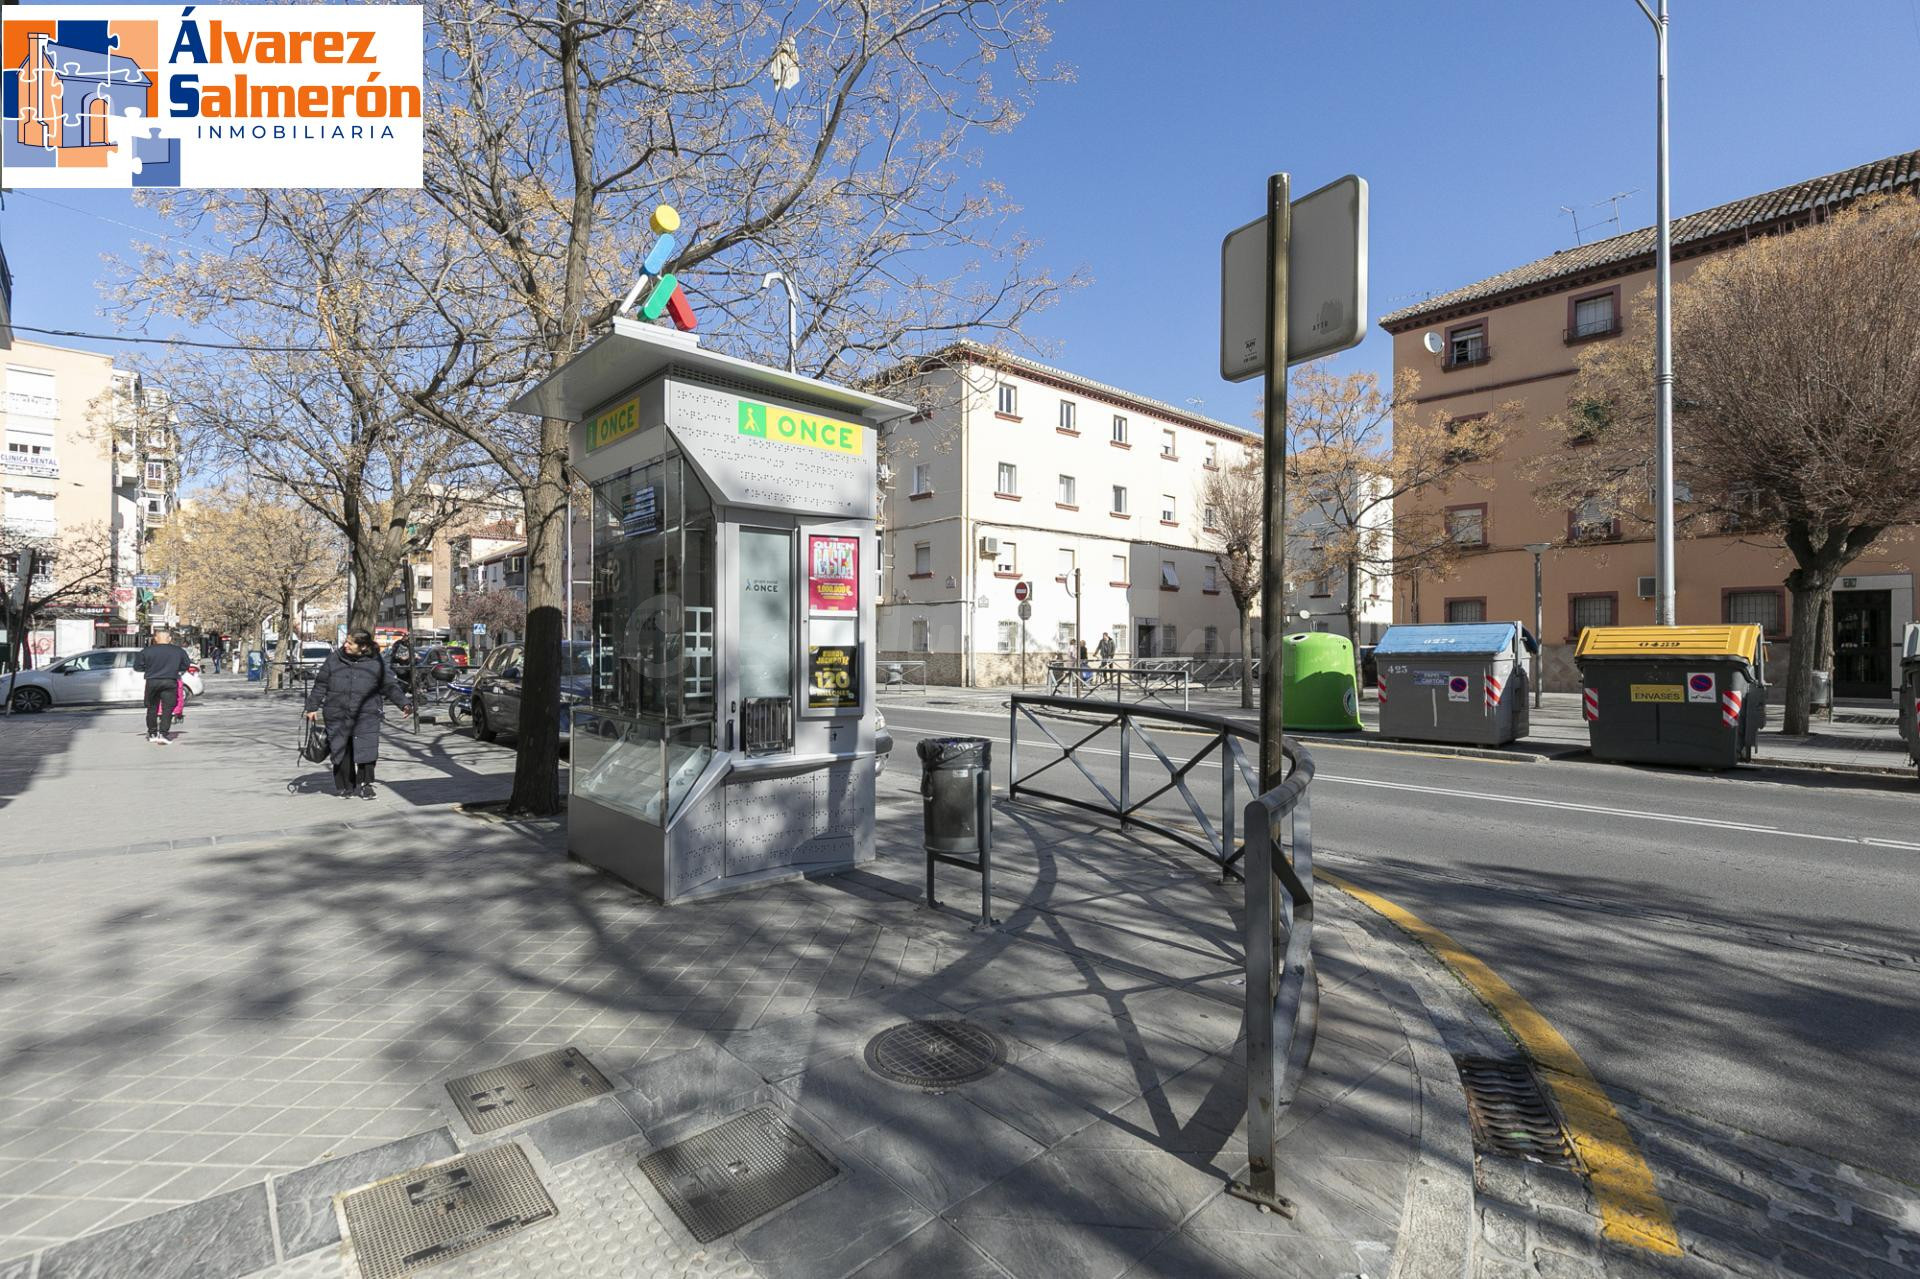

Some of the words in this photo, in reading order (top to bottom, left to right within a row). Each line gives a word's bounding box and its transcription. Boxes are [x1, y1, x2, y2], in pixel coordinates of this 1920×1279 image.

[600, 404, 635, 441] ONCE
[777, 414, 854, 449] ONCE
[753, 584, 778, 593] ONCE
[814, 670, 850, 689] 120
[1634, 692, 1681, 701] ENVASES
